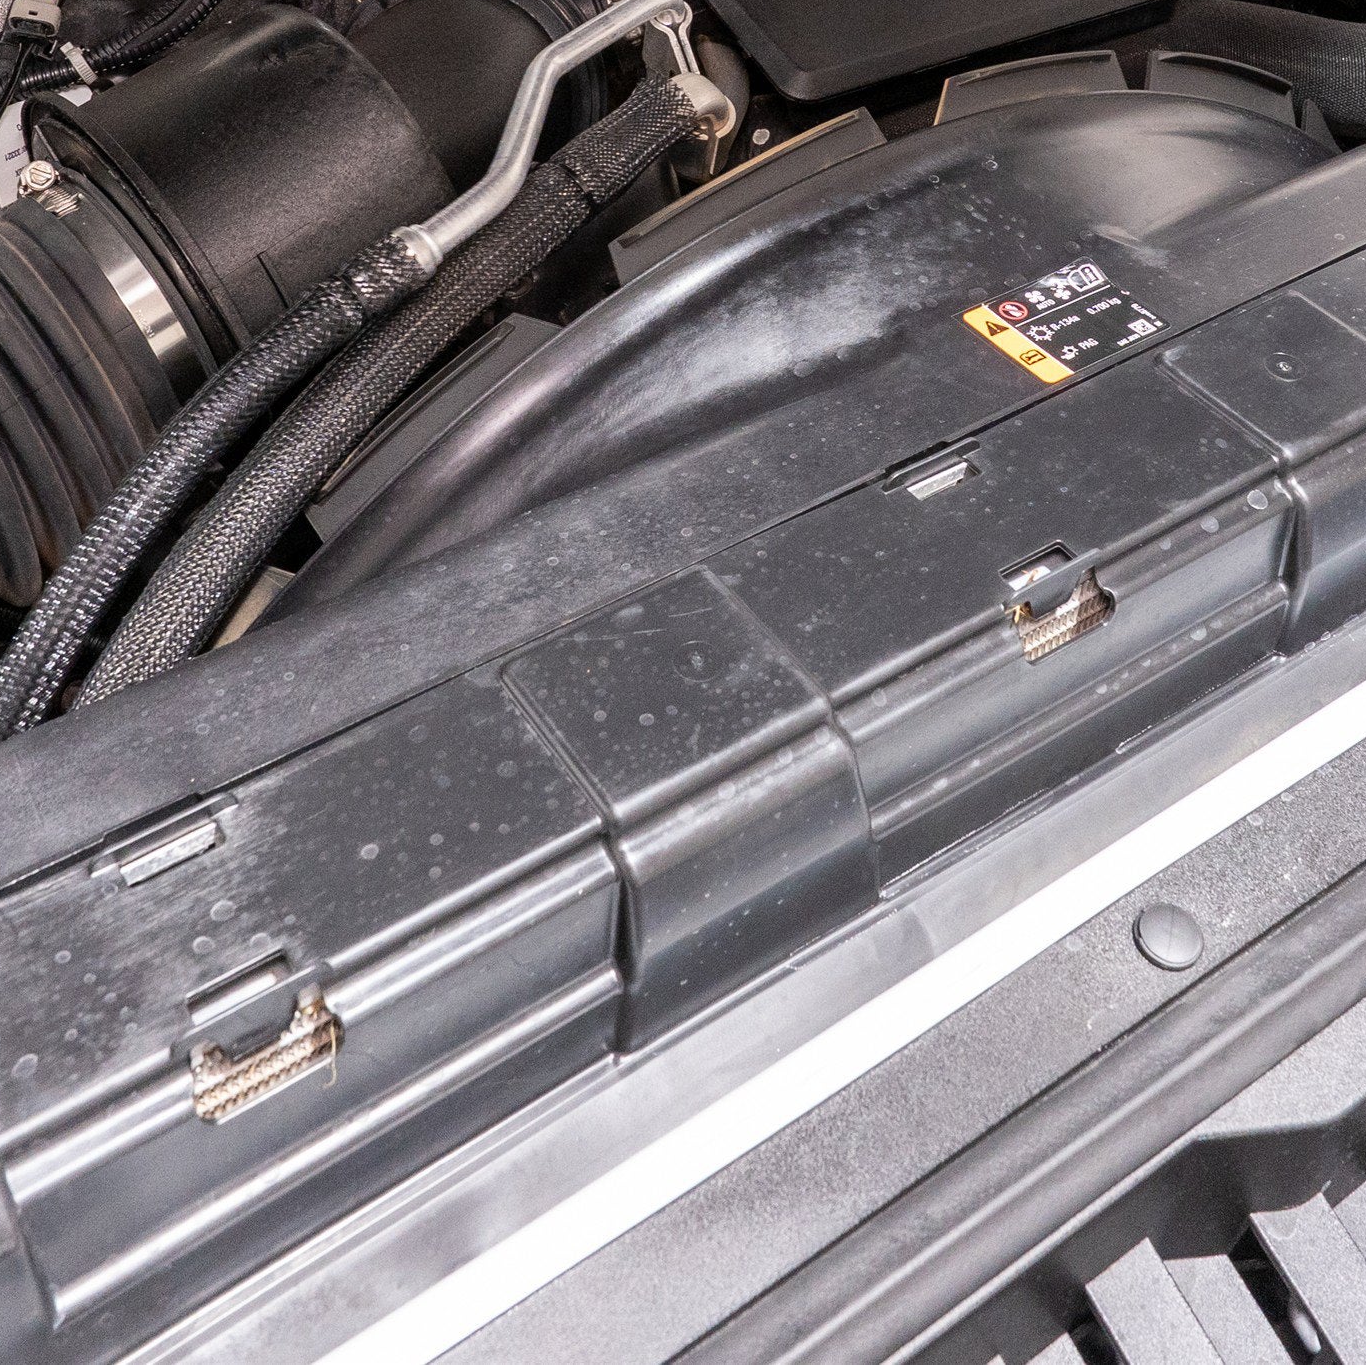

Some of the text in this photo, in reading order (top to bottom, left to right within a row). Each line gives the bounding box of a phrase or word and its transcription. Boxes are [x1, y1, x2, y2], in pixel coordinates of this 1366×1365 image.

[1035, 298, 1057, 311] AUTO
[1051, 297, 1122, 332] R-134a 0.700 kg
[1078, 338, 1099, 350] PAG
